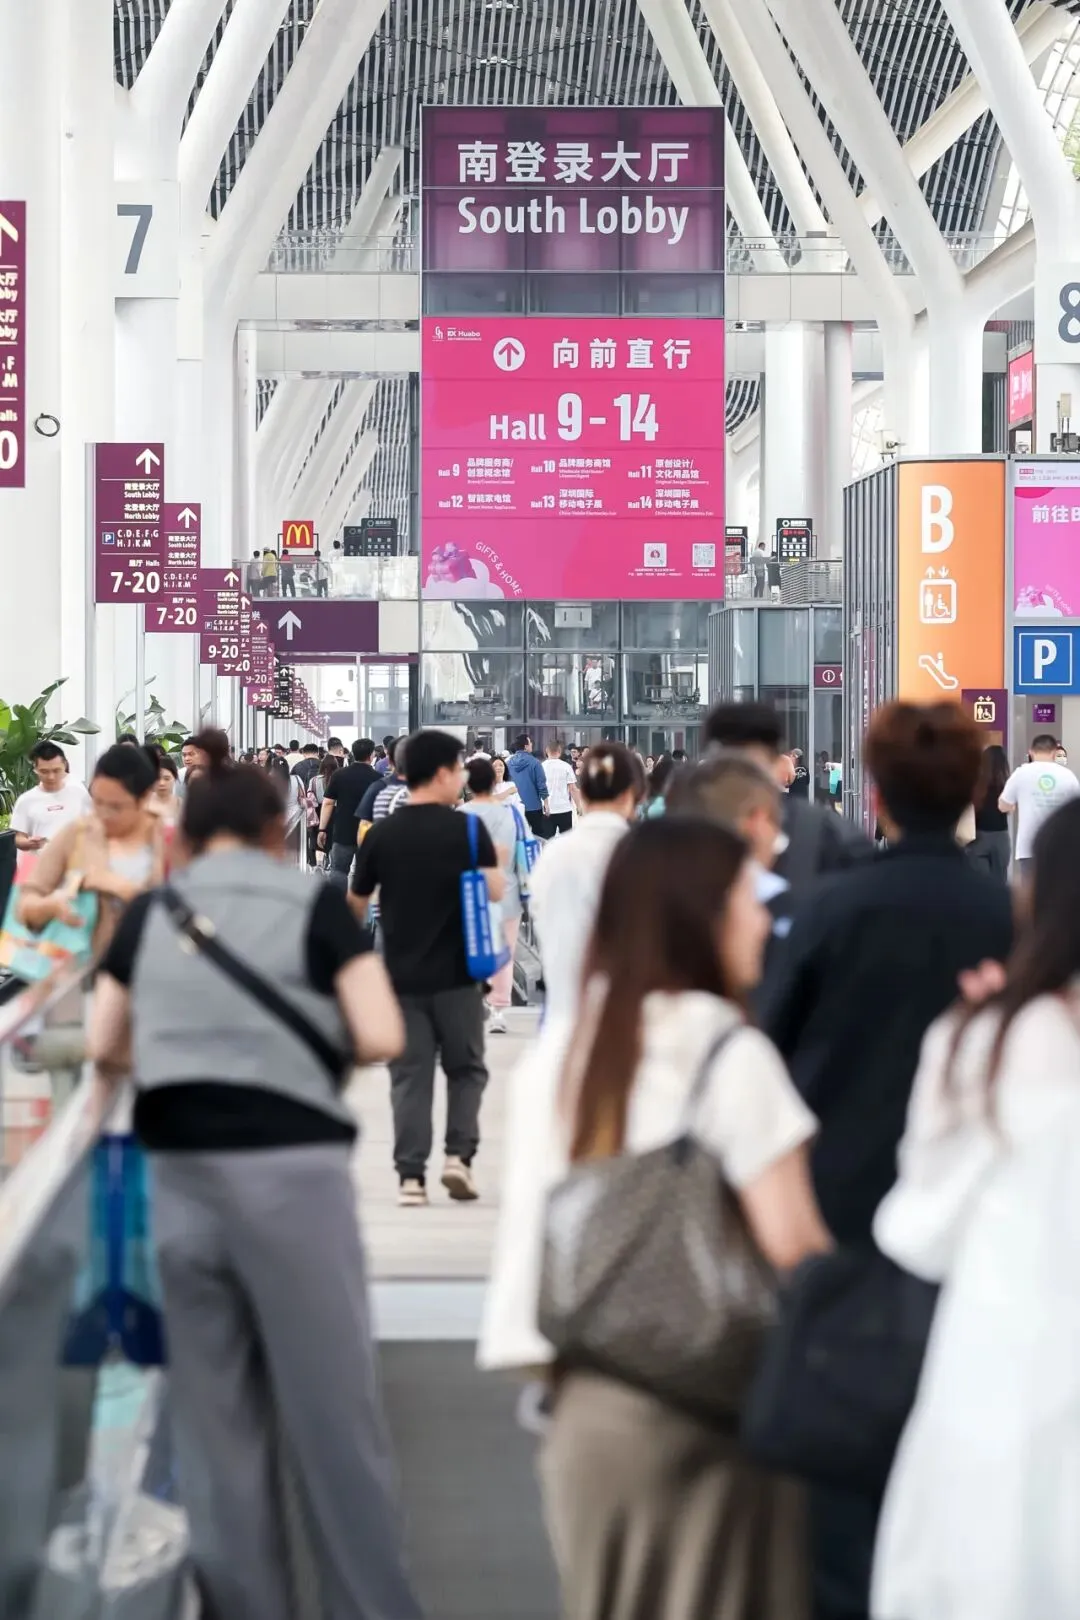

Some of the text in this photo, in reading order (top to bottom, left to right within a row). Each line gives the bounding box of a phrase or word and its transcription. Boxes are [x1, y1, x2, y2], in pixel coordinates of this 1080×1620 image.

[458, 141, 689, 183] 南登录大厅
[459, 196, 688, 245] South Lobby
[117, 203, 153, 274] 7
[1058, 282, 1080, 343] 8
[554, 338, 690, 369] 向前直行
[490, 414, 546, 440] Hall
[452, 464, 460, 476] 9
[543, 460, 556, 473] 10
[640, 465, 652, 478] 11
[124, 491, 160, 500] South Lobby
[450, 495, 464, 507] 12
[540, 496, 555, 508] 13
[639, 496, 653, 508] 14
[921, 485, 953, 553] B
[475, 541, 522, 596] GIFTS & HOME
[111, 572, 160, 593] 7-20
[157, 608, 196, 624] 7-20
[208, 645, 239, 658] 9-20
[1034, 640, 1056, 679] P
[252, 692, 273, 703] 9-20
